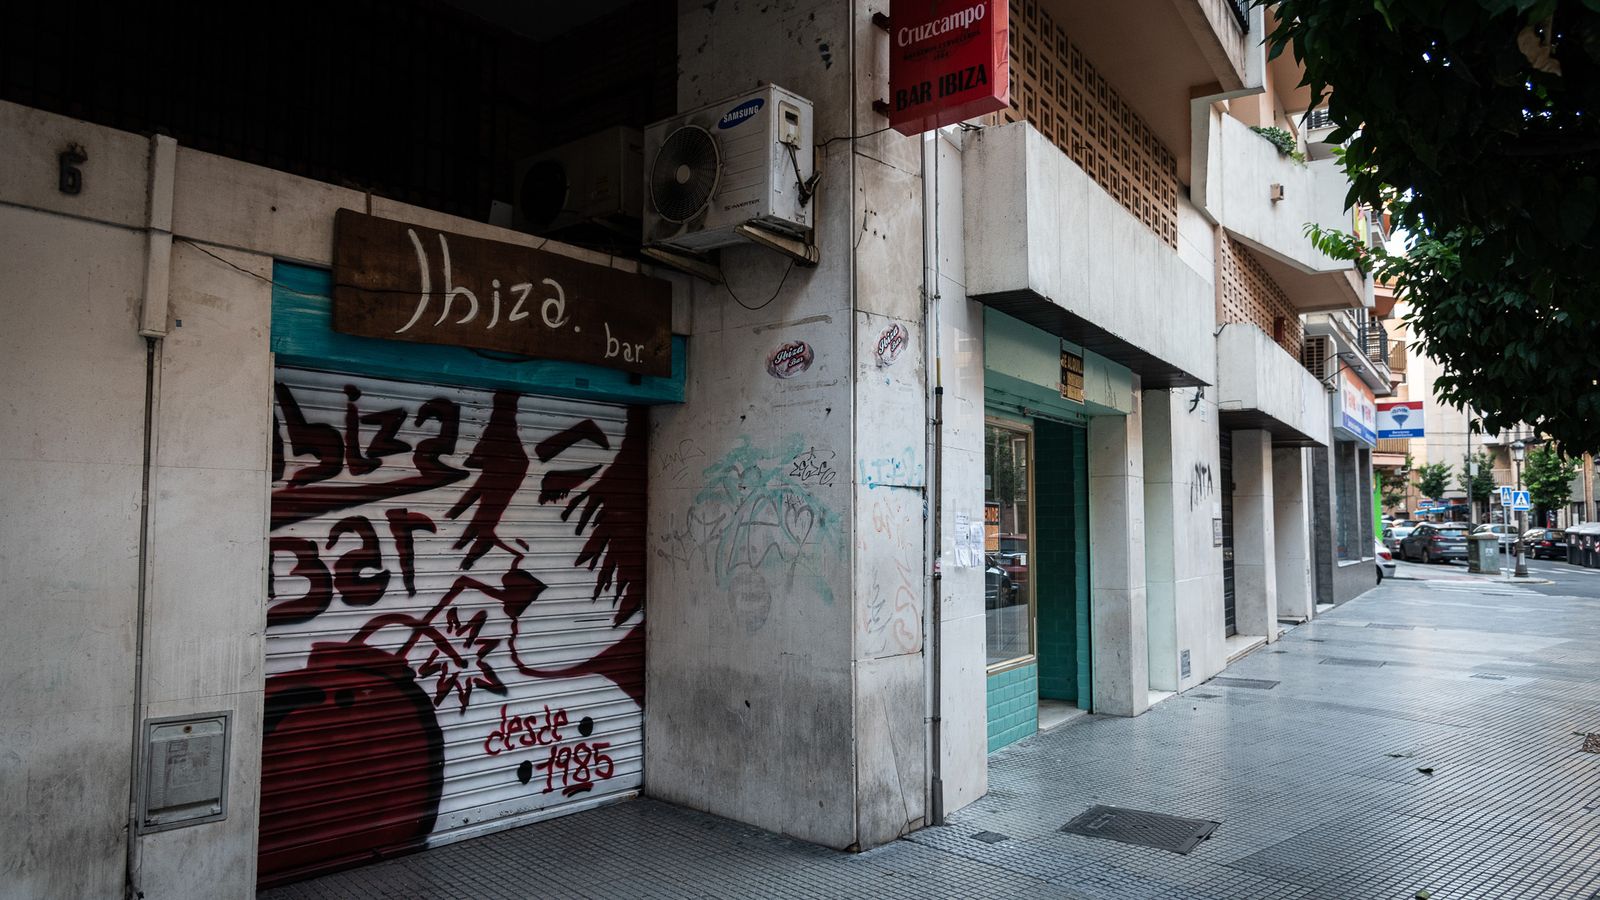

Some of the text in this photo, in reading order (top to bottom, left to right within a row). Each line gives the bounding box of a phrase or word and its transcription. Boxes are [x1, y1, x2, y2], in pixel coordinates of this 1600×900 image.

[897, 3, 985, 47] Cruzcampo
[896, 64, 988, 112] BAR IBIZA
[723, 104, 760, 123] SAMSUNG
[58, 148, 86, 197] 6
[775, 343, 804, 365] Ibiza
[878, 324, 899, 355] Ibiza
[267, 507, 437, 627] Bar
[484, 703, 569, 756] desde
[535, 742, 614, 794] 1985
